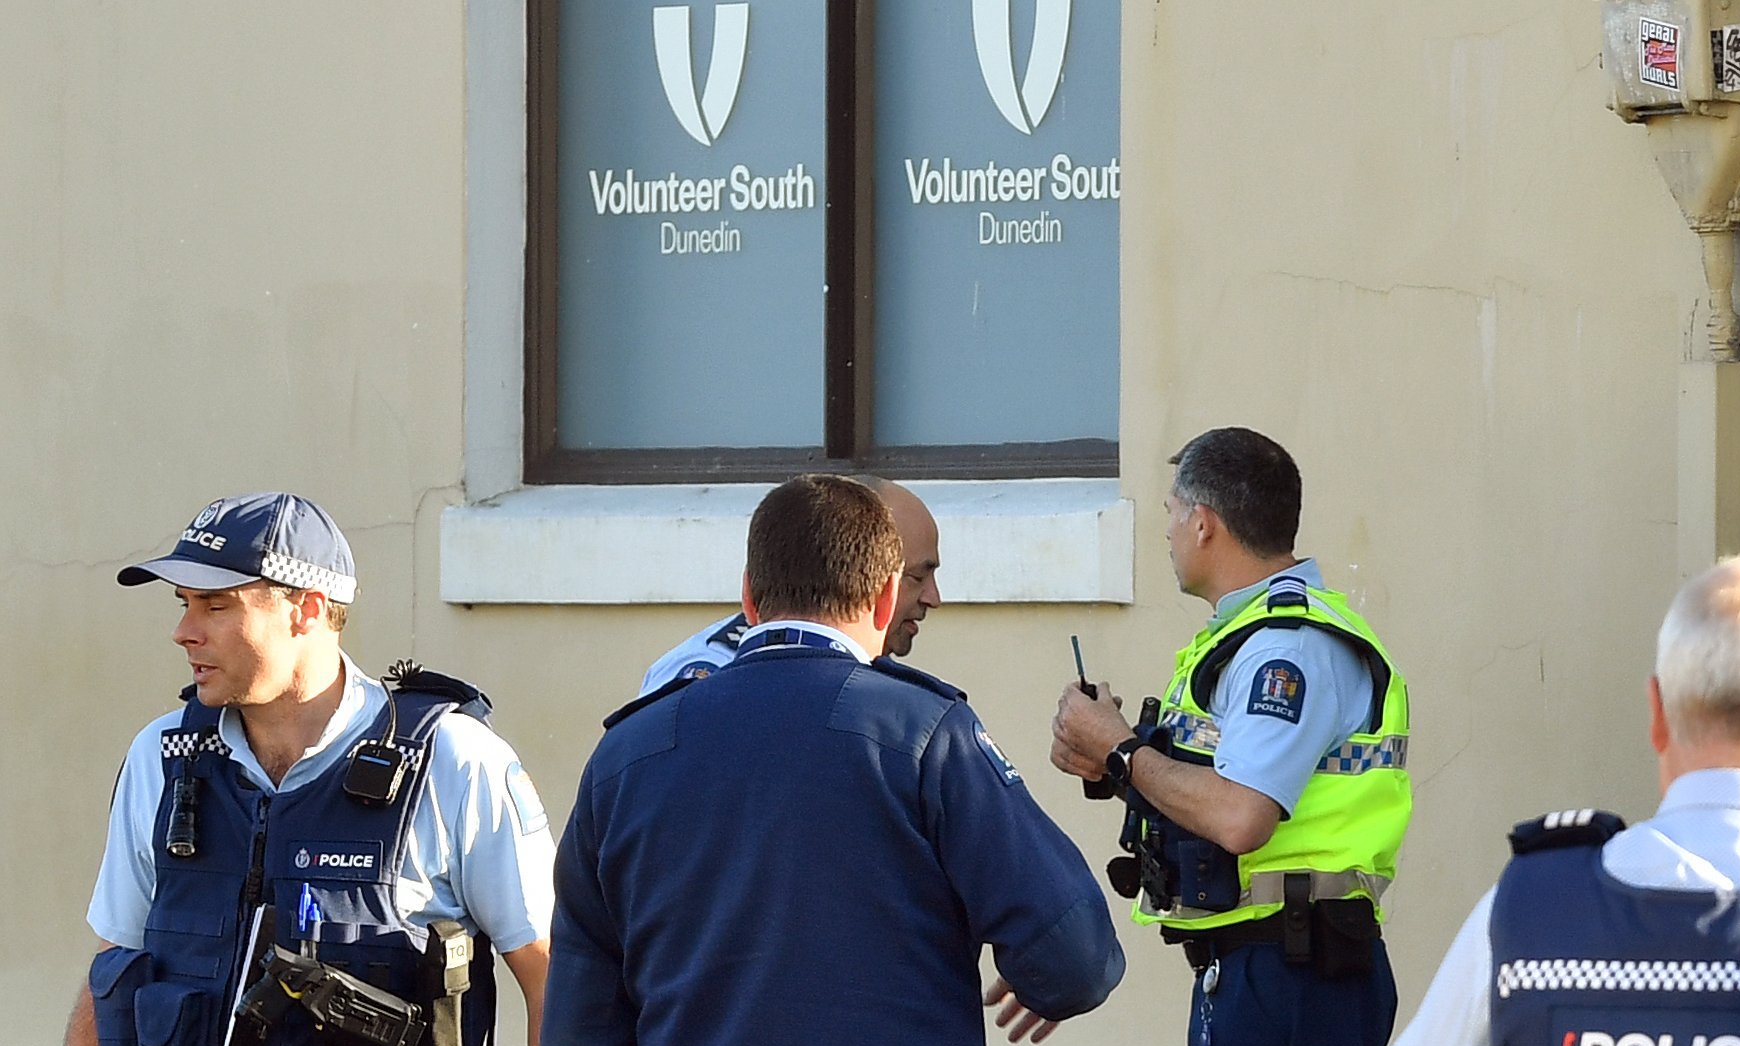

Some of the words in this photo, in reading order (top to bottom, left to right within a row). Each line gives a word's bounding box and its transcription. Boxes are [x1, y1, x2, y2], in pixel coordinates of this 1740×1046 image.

[589, 169, 726, 214] Volunteer
[730, 164, 814, 211] South
[905, 158, 1047, 204] Volunteer
[1051, 154, 1121, 200] Sout
[661, 220, 741, 254] Dunedin
[979, 211, 1062, 245] Dunedin
[1253, 702, 1295, 718] POLICE
[319, 853, 374, 868] POLICE
[449, 944, 465, 959] TQ
